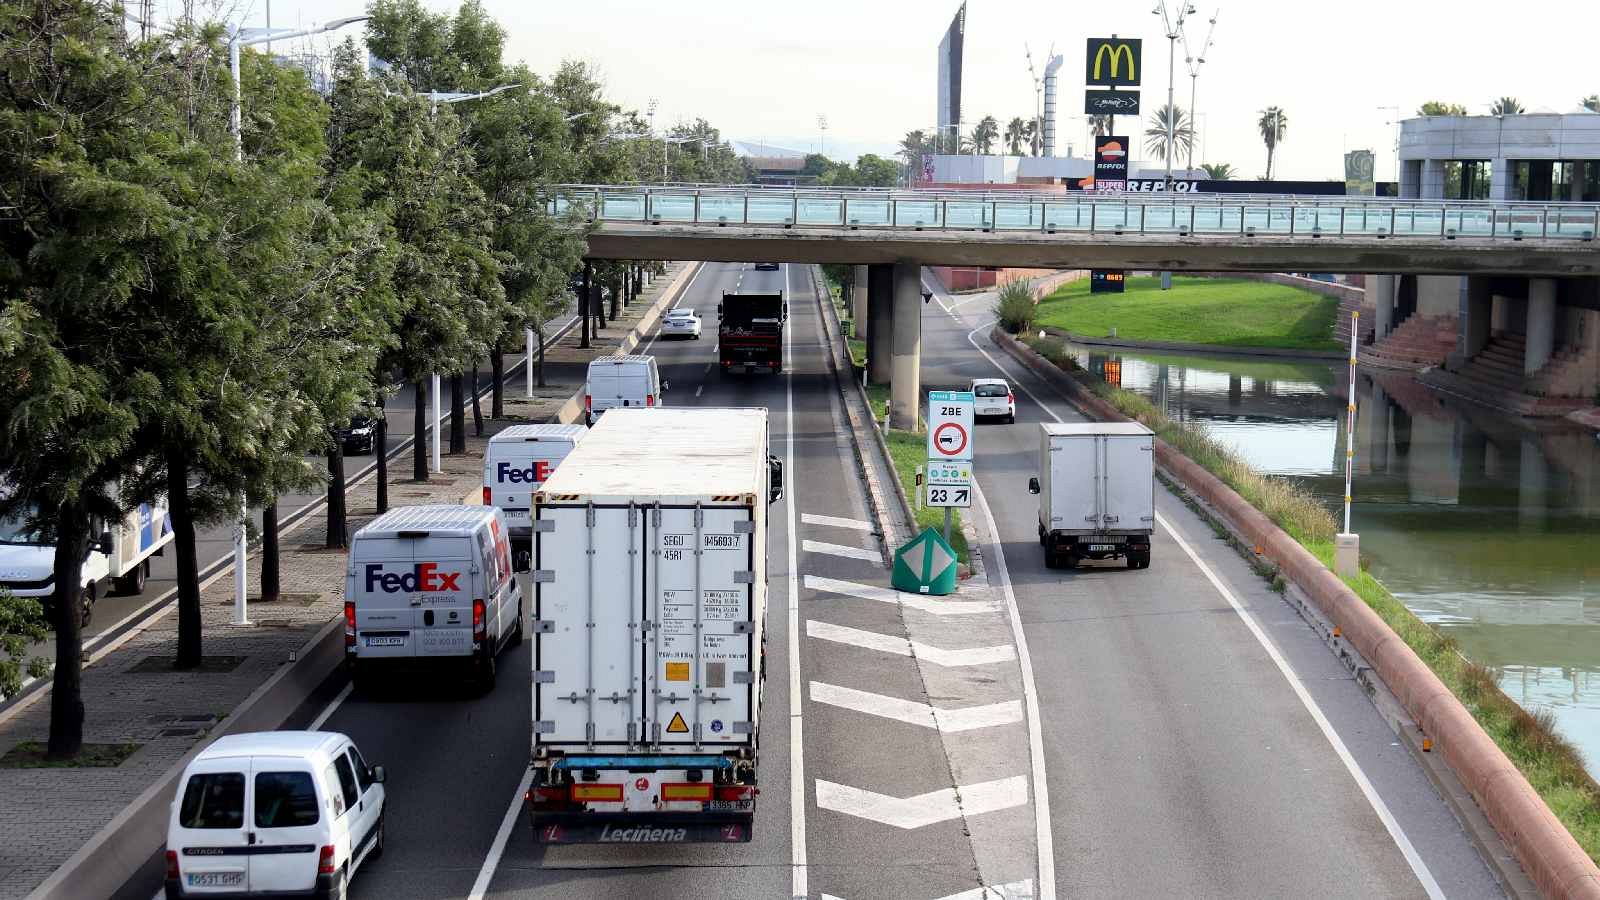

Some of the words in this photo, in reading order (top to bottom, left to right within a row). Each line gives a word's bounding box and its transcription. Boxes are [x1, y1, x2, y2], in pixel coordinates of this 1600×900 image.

[1127, 181, 1199, 192] REPOL
[941, 407, 962, 416] ZBE
[497, 461, 554, 483] FedE
[930, 489, 948, 503] 23
[664, 535, 684, 546] SEGU
[664, 550, 683, 561] 45R1
[365, 562, 461, 593] FedEx
[600, 825, 687, 842] Leciñena
